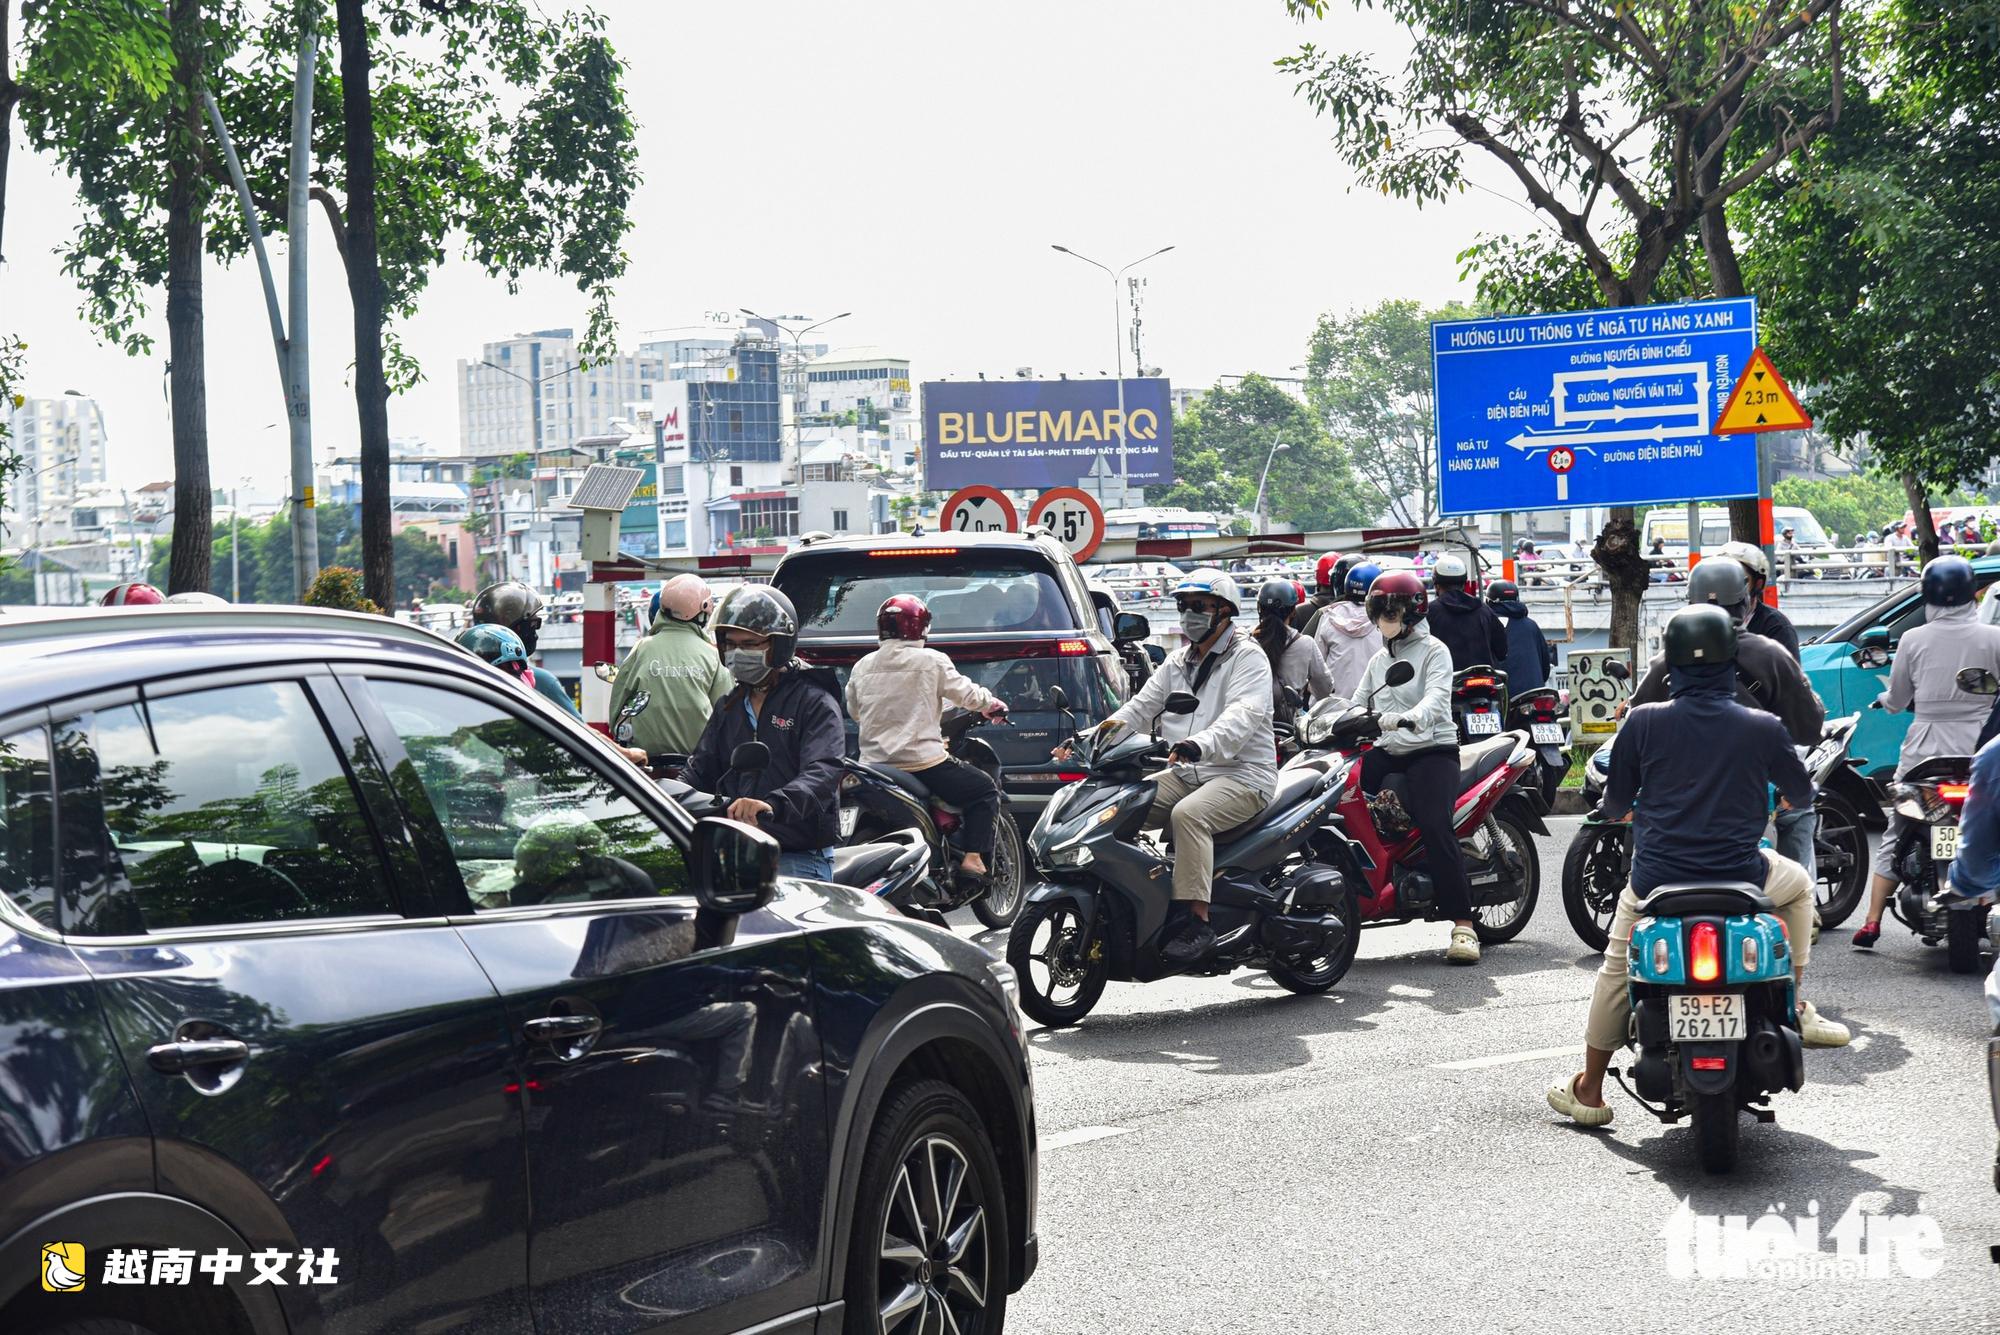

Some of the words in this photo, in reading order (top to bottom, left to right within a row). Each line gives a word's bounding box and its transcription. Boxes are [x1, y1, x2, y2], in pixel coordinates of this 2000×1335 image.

[1451, 327, 1495, 347] HƯỚNG
[1498, 327, 1525, 344] LƯU
[1529, 322, 1573, 341] THÔNG
[1576, 316, 1594, 338] VỀ
[1599, 317, 1627, 336] NGÃ
[1629, 317, 1648, 334] TƯ
[1652, 312, 1691, 332] HÀNG
[1694, 311, 1734, 329] XANH
[1570, 351, 1601, 365] ĐƯỜNG
[1603, 344, 1640, 362] NGUYỄN
[1641, 344, 1663, 360] ĐÌNH
[1665, 339, 1692, 357] CHIỂU
[1508, 387, 1527, 400] CẦU
[1577, 390, 1610, 403] ĐƯỜNG
[1612, 383, 1647, 400] NGUYỄN
[1648, 383, 1665, 398] VĂN
[1666, 378, 1683, 396] THỦ
[1744, 390, 1764, 406] 2.3
[1766, 391, 1779, 403] m
[1487, 404, 1508, 421] ĐIỆN
[1509, 403, 1530, 418] BIÊN
[1531, 399, 1550, 417] PHỦ
[939, 408, 1158, 444] BLUEMARQ
[1048, 447, 1070, 457] PHÁT
[1456, 438, 1475, 451] NGÃ
[1477, 440, 1488, 450] TƯ
[1603, 449, 1636, 462] ĐƯỜNG
[1638, 444, 1659, 463] ĐIỆN
[1660, 443, 1682, 458] BIÊN
[1683, 440, 1703, 457] PHỦ
[1448, 455, 1473, 471] HÀNG
[1474, 456, 1500, 470] XANH
[1680, 996, 1733, 1016] 59-E2
[1676, 1017, 1738, 1038] 262.17
